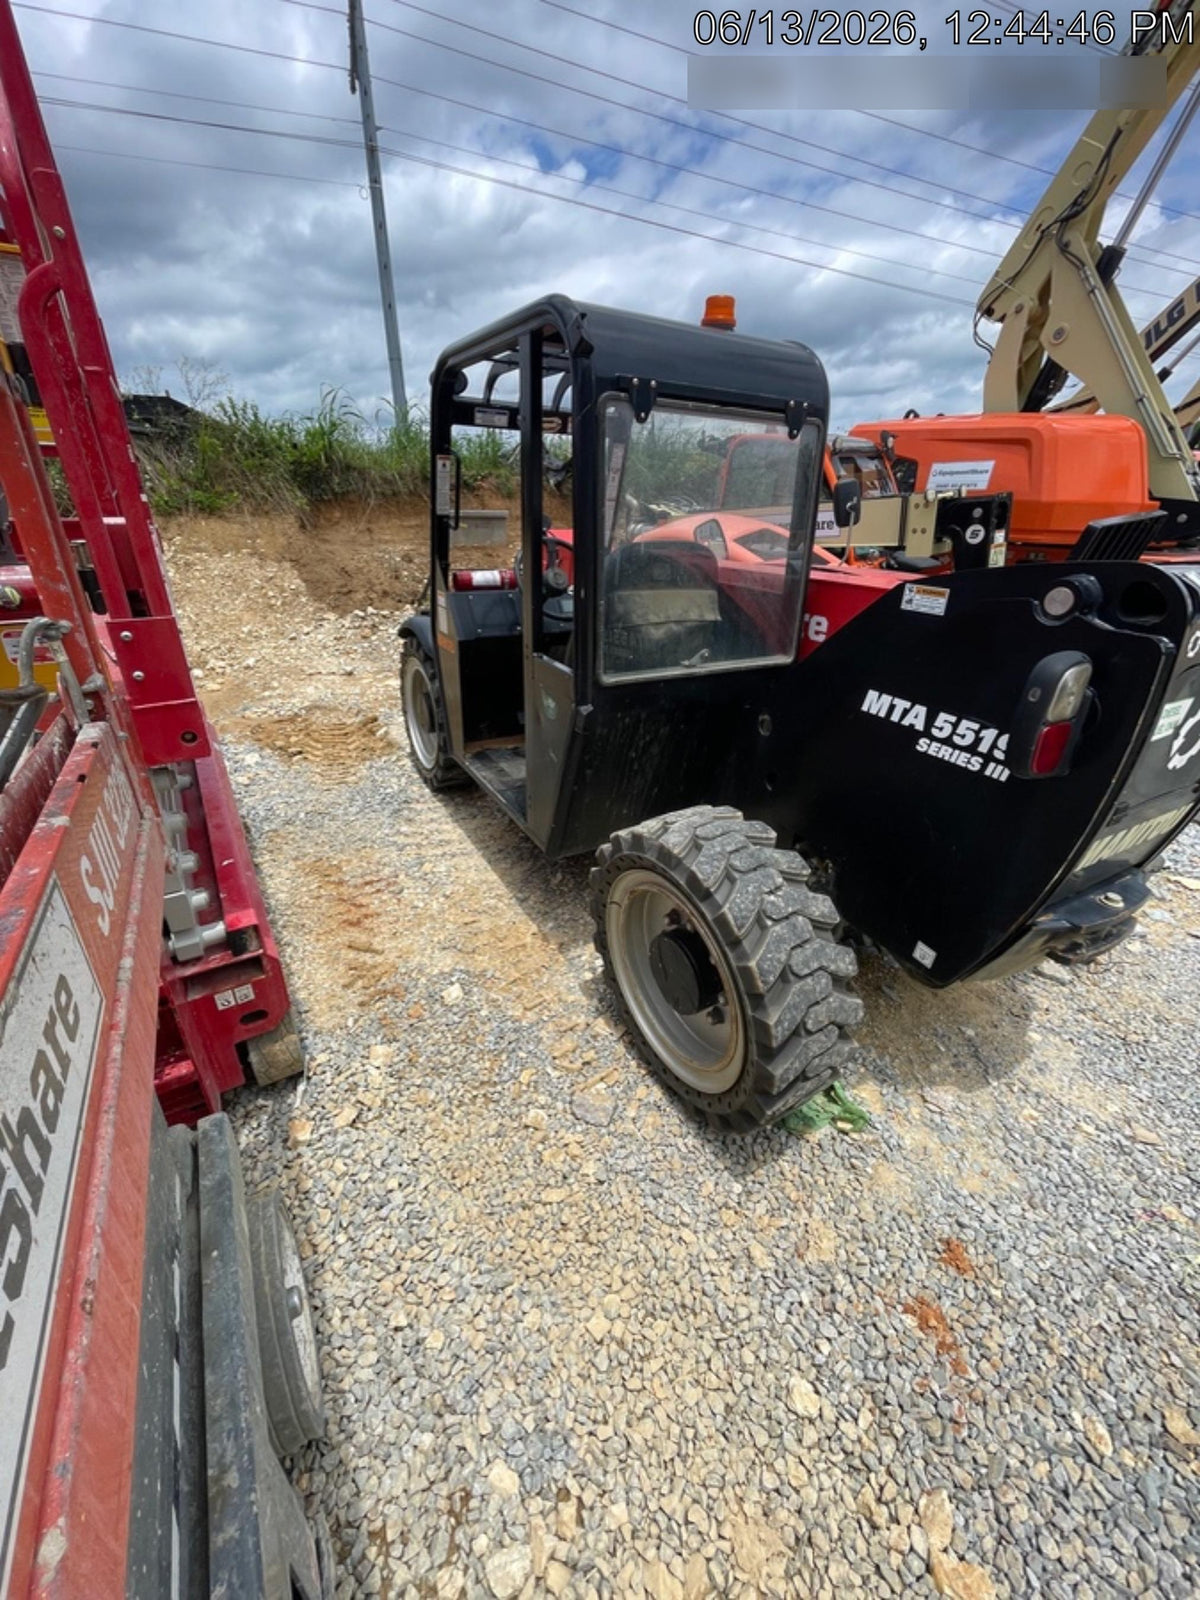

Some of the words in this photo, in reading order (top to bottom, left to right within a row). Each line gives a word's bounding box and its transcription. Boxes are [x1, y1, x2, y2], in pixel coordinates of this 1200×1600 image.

[861, 689, 928, 732] MTA
[915, 737, 984, 772] SERIES
[984, 761, 1011, 782] III
